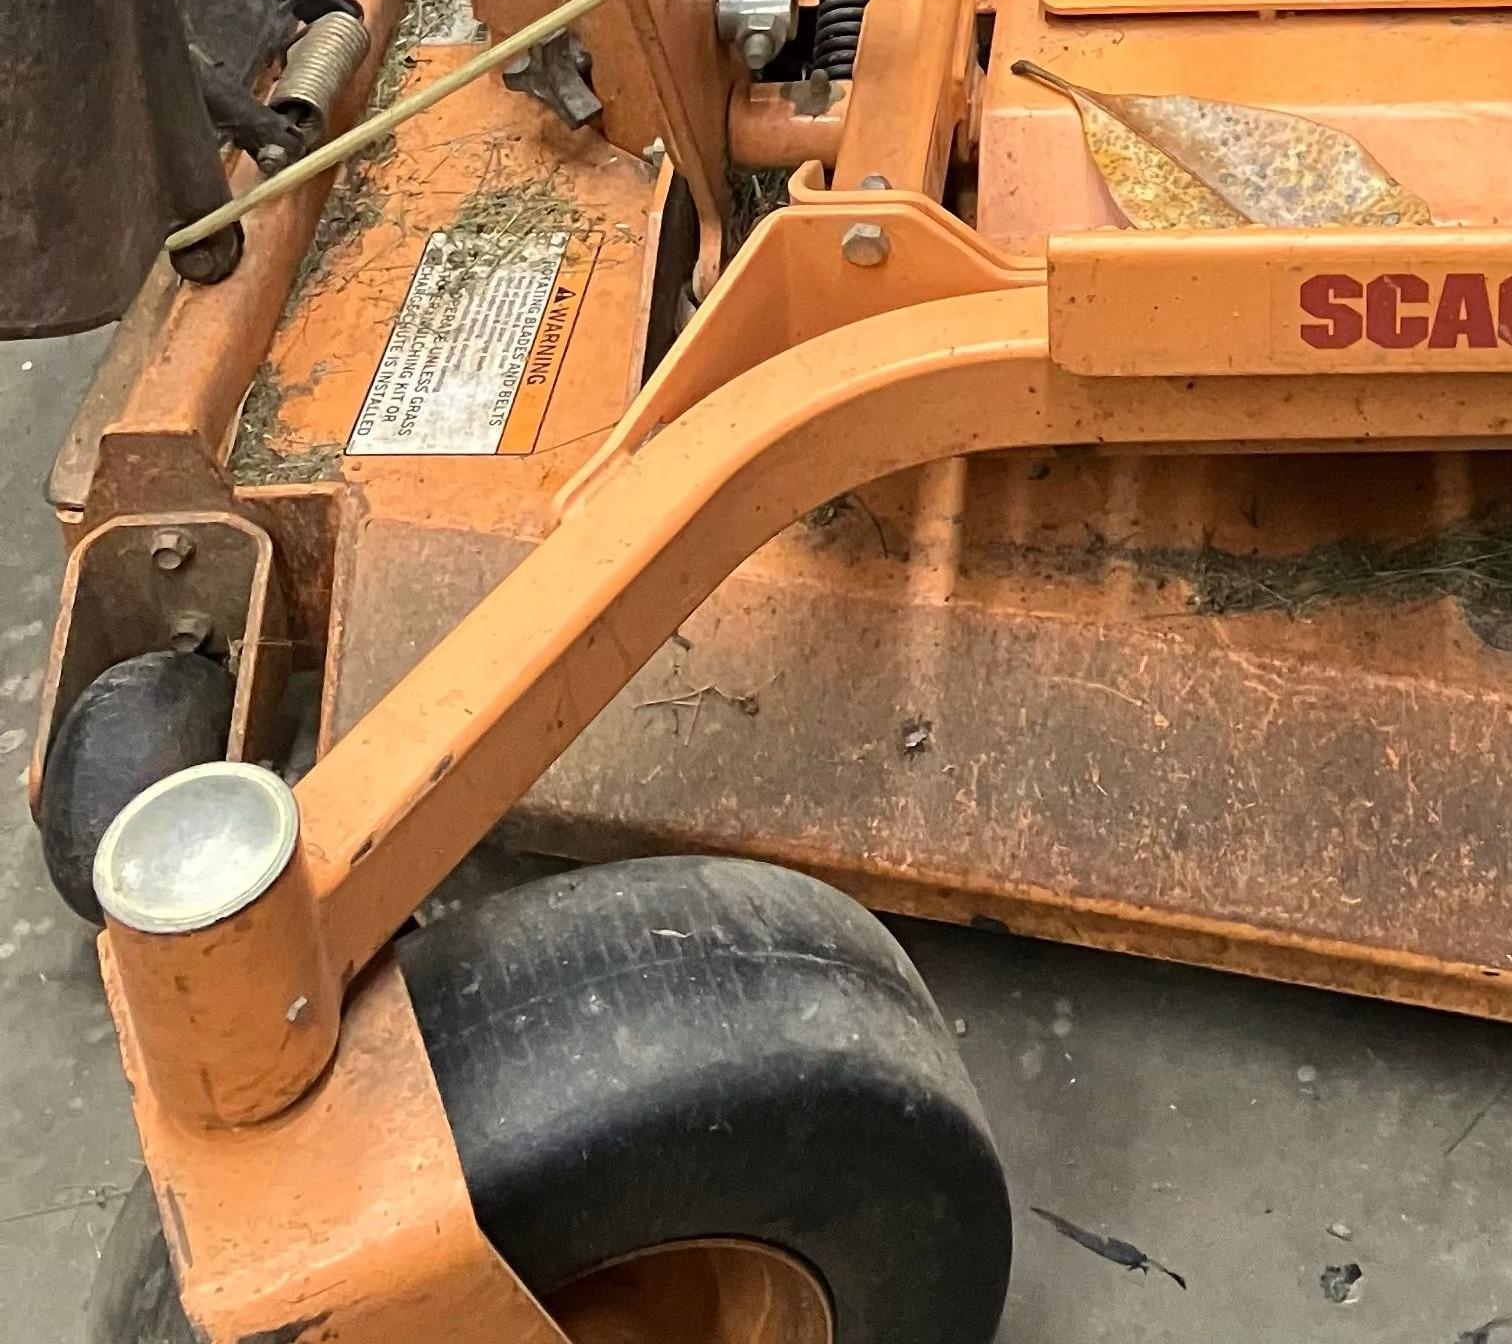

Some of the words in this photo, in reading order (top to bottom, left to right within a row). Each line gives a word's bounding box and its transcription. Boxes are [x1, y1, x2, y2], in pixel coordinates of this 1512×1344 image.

[527, 261, 556, 313] ROTATING
[510, 317, 537, 358] BLADES
[525, 307, 569, 385] WARNING
[413, 347, 443, 392] UNLESS
[501, 363, 522, 386] AND
[356, 371, 394, 435] INSTALLED
[389, 382, 410, 400] KIT
[487, 391, 513, 425] BELTS
[381, 405, 401, 422] OR
[397, 397, 424, 435] GRASS
